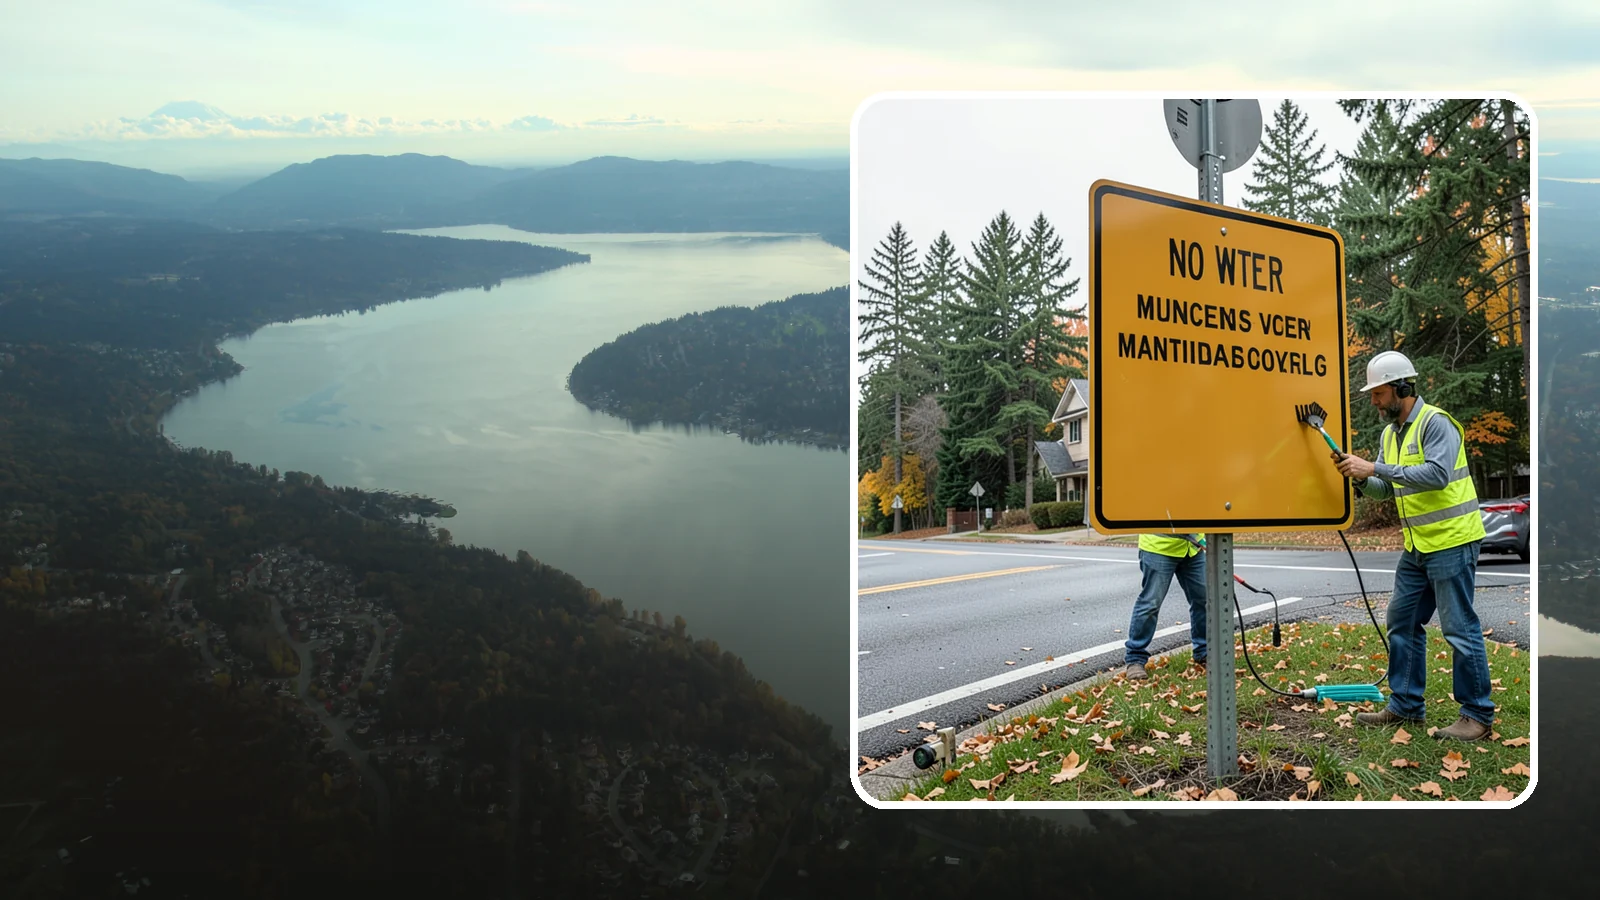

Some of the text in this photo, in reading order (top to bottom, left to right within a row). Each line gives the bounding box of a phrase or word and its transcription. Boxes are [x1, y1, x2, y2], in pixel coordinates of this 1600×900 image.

[1169, 238, 1284, 294] NO WTER
[1137, 294, 1252, 333] MUNCENS
